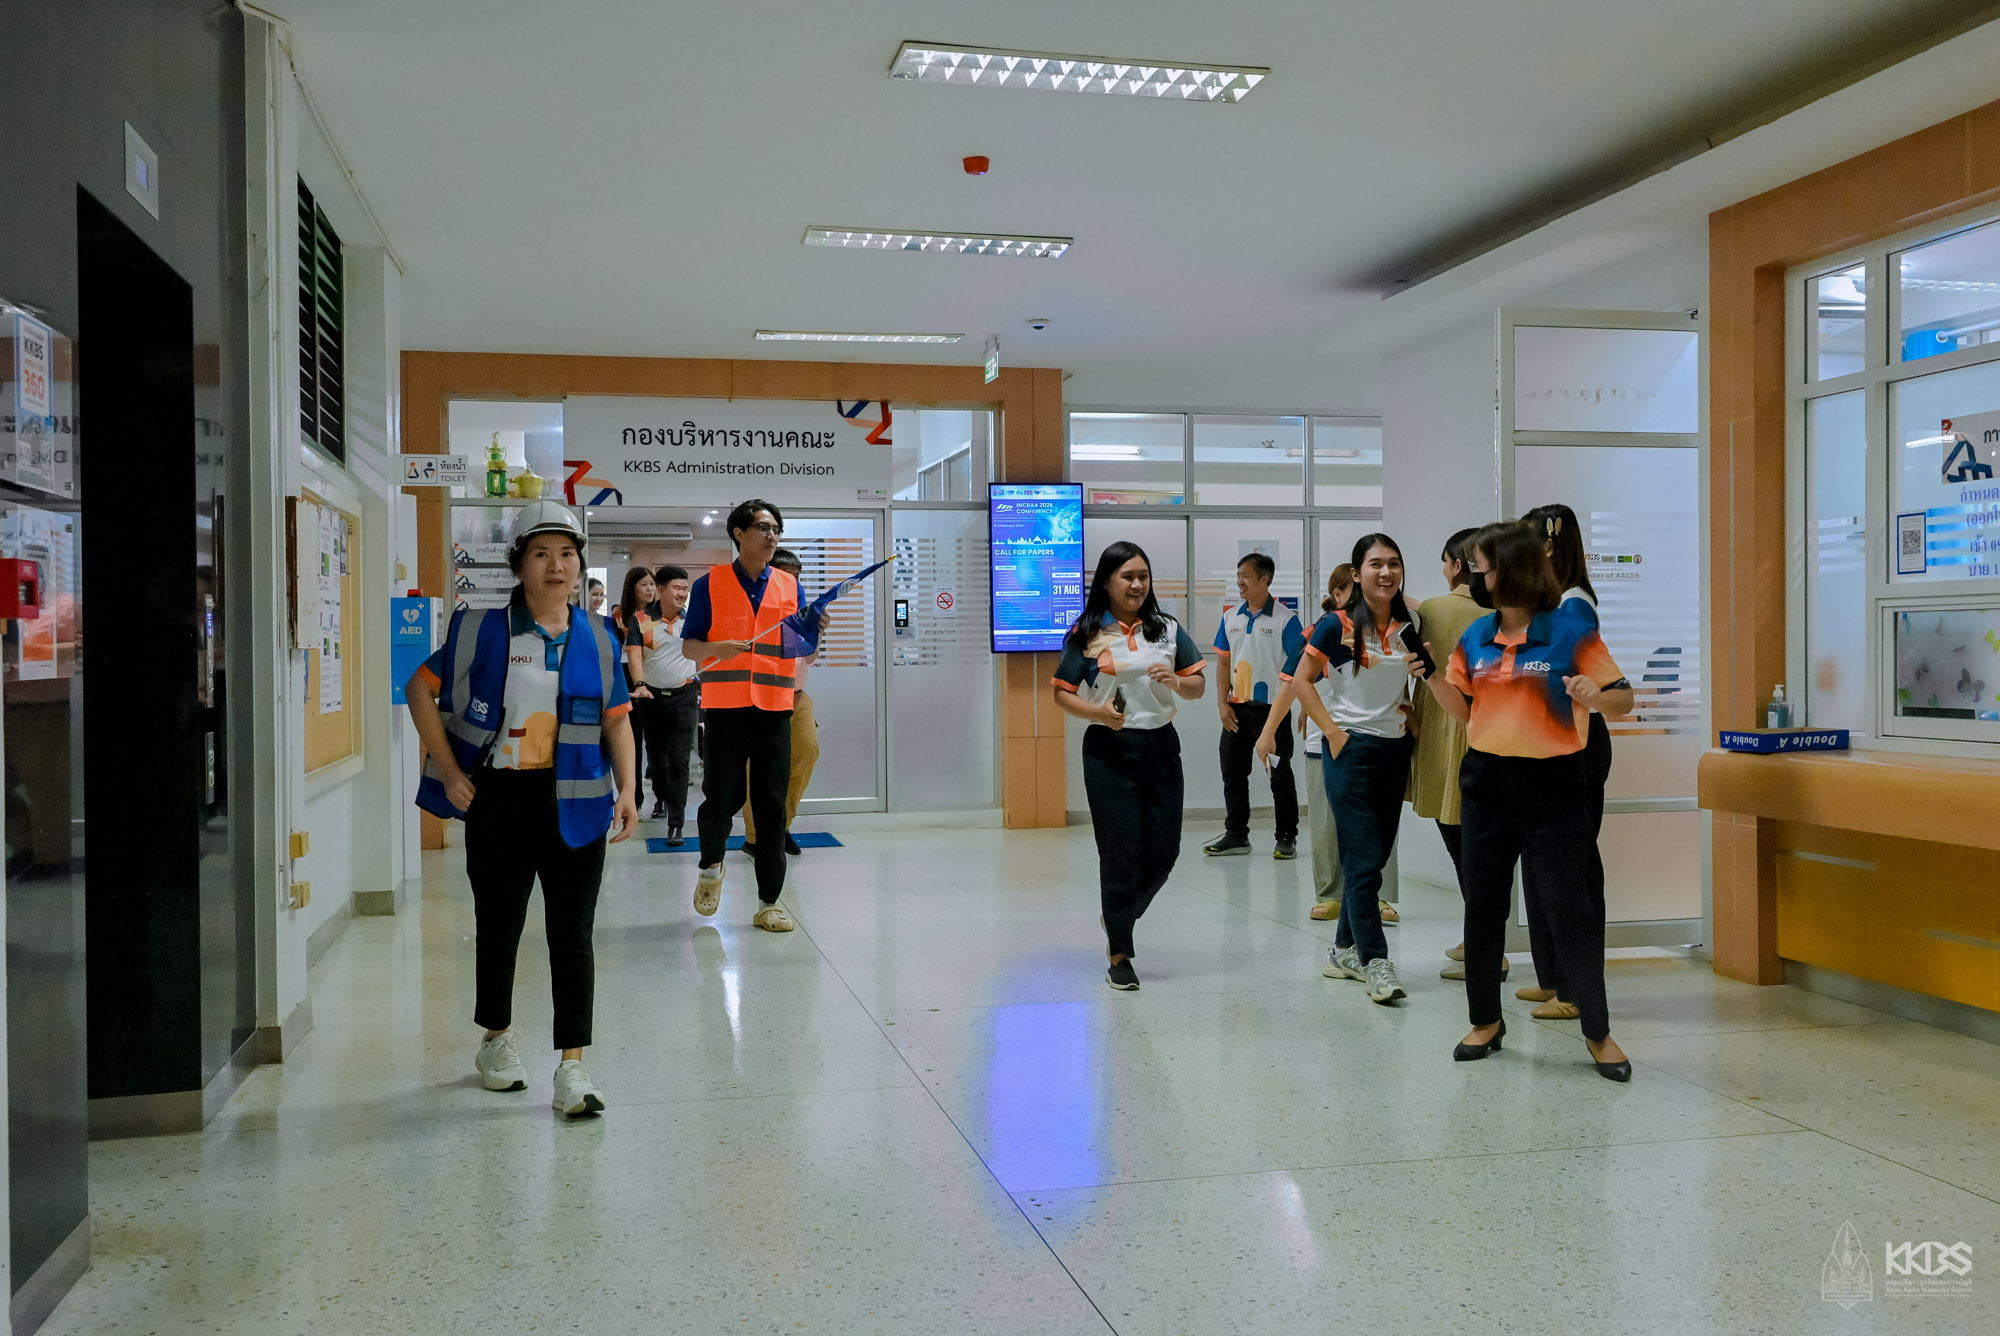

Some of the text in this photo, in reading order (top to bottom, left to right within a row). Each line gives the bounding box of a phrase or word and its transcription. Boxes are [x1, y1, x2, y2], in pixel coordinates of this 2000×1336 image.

[24, 336, 44, 361] KKBS
[24, 368, 45, 400] 360
[622, 420, 835, 448] กองบริหารงานคณะ
[1984, 428, 2000, 443] กา
[440, 458, 466, 470] ห้องน้ำ
[624, 460, 835, 476] KKBS Administration Division
[1960, 486, 1999, 502] กำหนด
[1967, 504, 2000, 528] (ออกใ
[1970, 534, 1987, 552] เช้า
[1968, 558, 1989, 576] บ่าย
[1064, 585, 1080, 594] AUG
[1524, 660, 1550, 672] KKBS
[1732, 735, 1758, 747] Double
[1780, 735, 1837, 748] Double A
